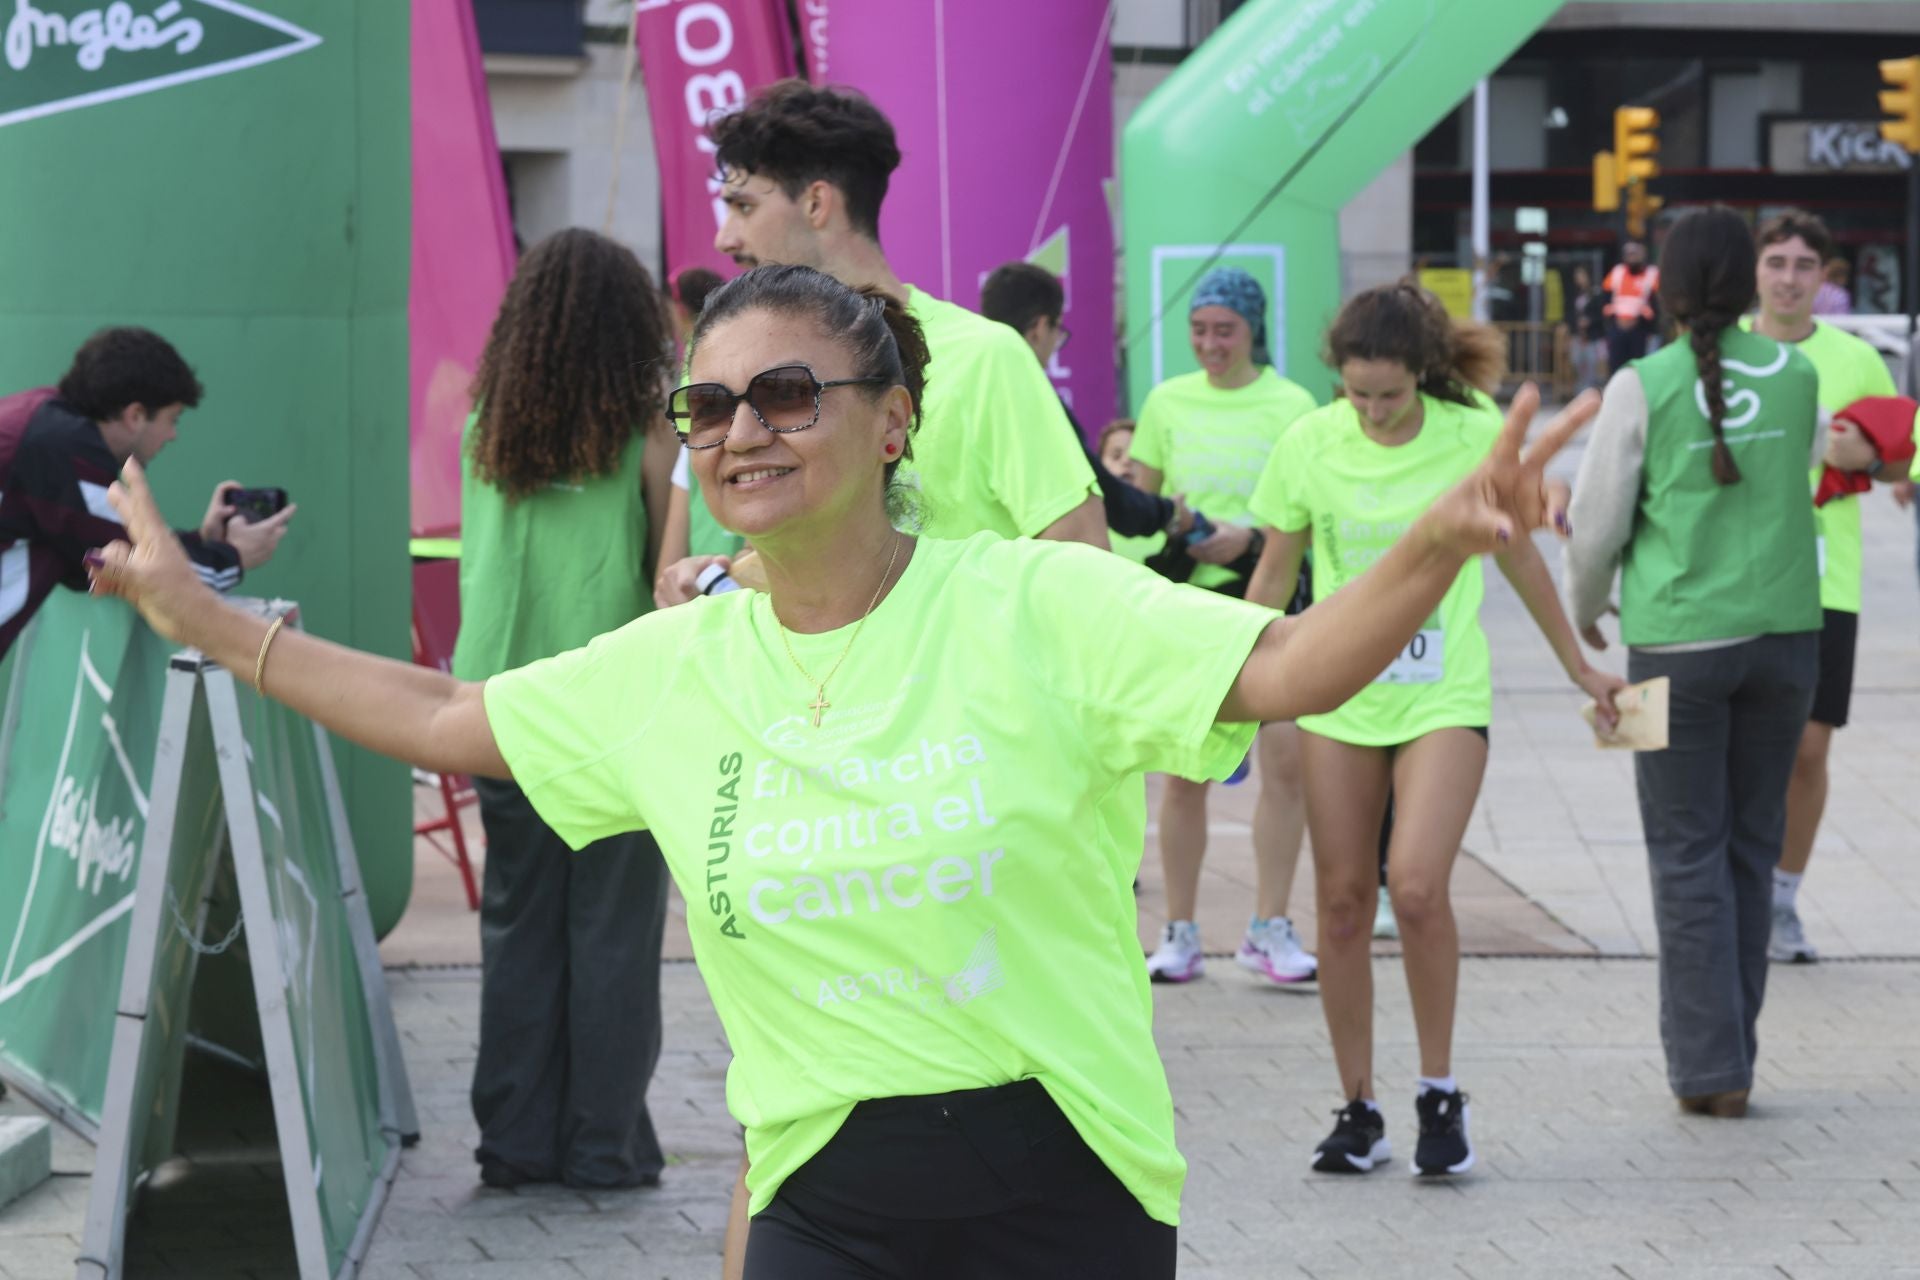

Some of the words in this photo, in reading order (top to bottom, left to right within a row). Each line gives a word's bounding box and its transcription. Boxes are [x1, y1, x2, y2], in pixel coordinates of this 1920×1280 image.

[743, 799, 923, 858] contra
[931, 776, 998, 832] el
[752, 757, 804, 801] En
[706, 751, 747, 940] ASTURIAS
[747, 846, 1006, 925] cáncer
